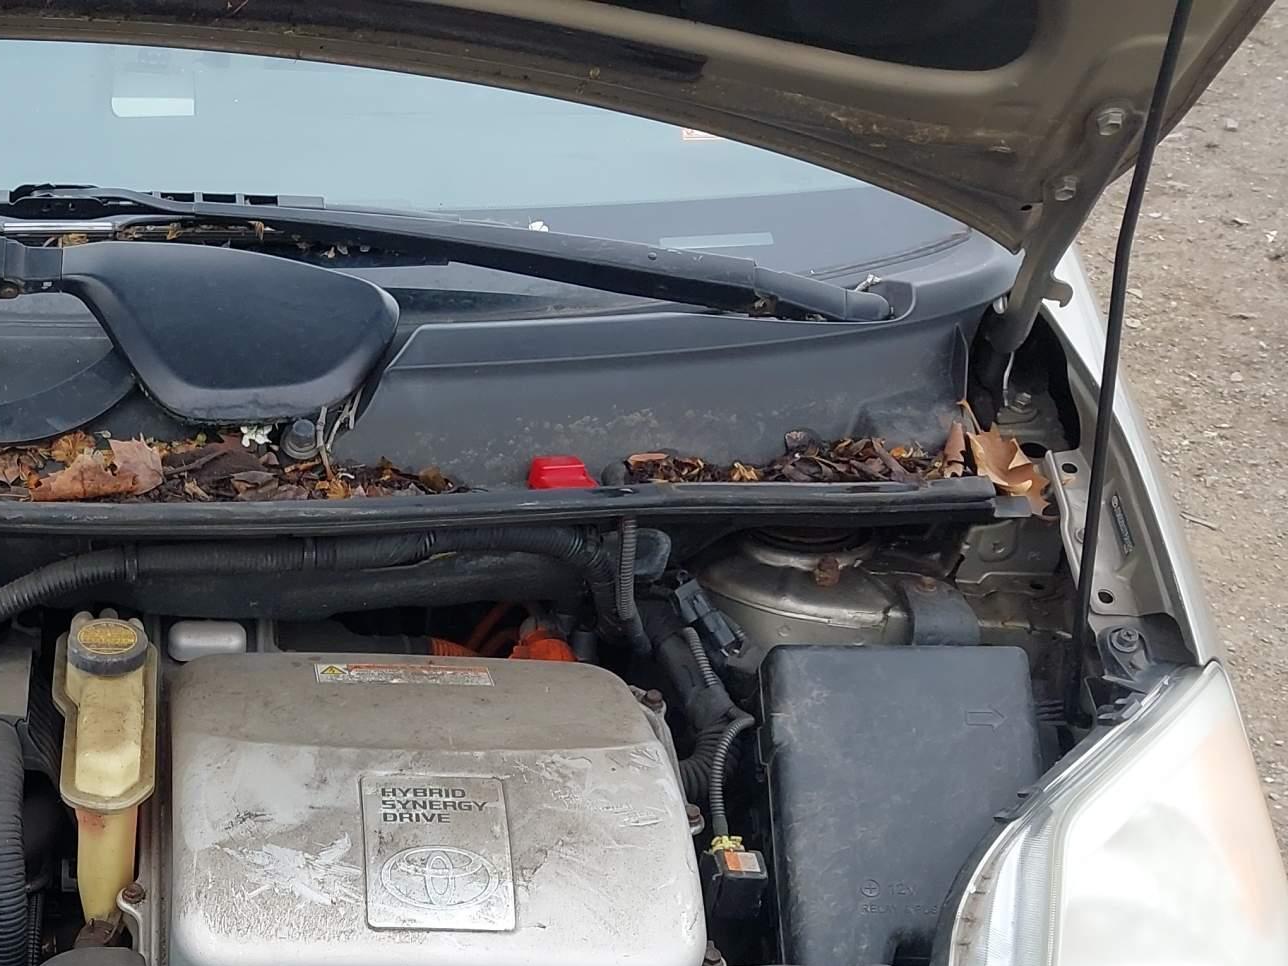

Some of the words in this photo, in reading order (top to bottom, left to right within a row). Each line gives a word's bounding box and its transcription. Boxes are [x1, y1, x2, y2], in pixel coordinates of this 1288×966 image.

[381, 787, 466, 799] HYBRID
[381, 799, 488, 812] SYNERGY
[383, 812, 451, 824] DRIVE
